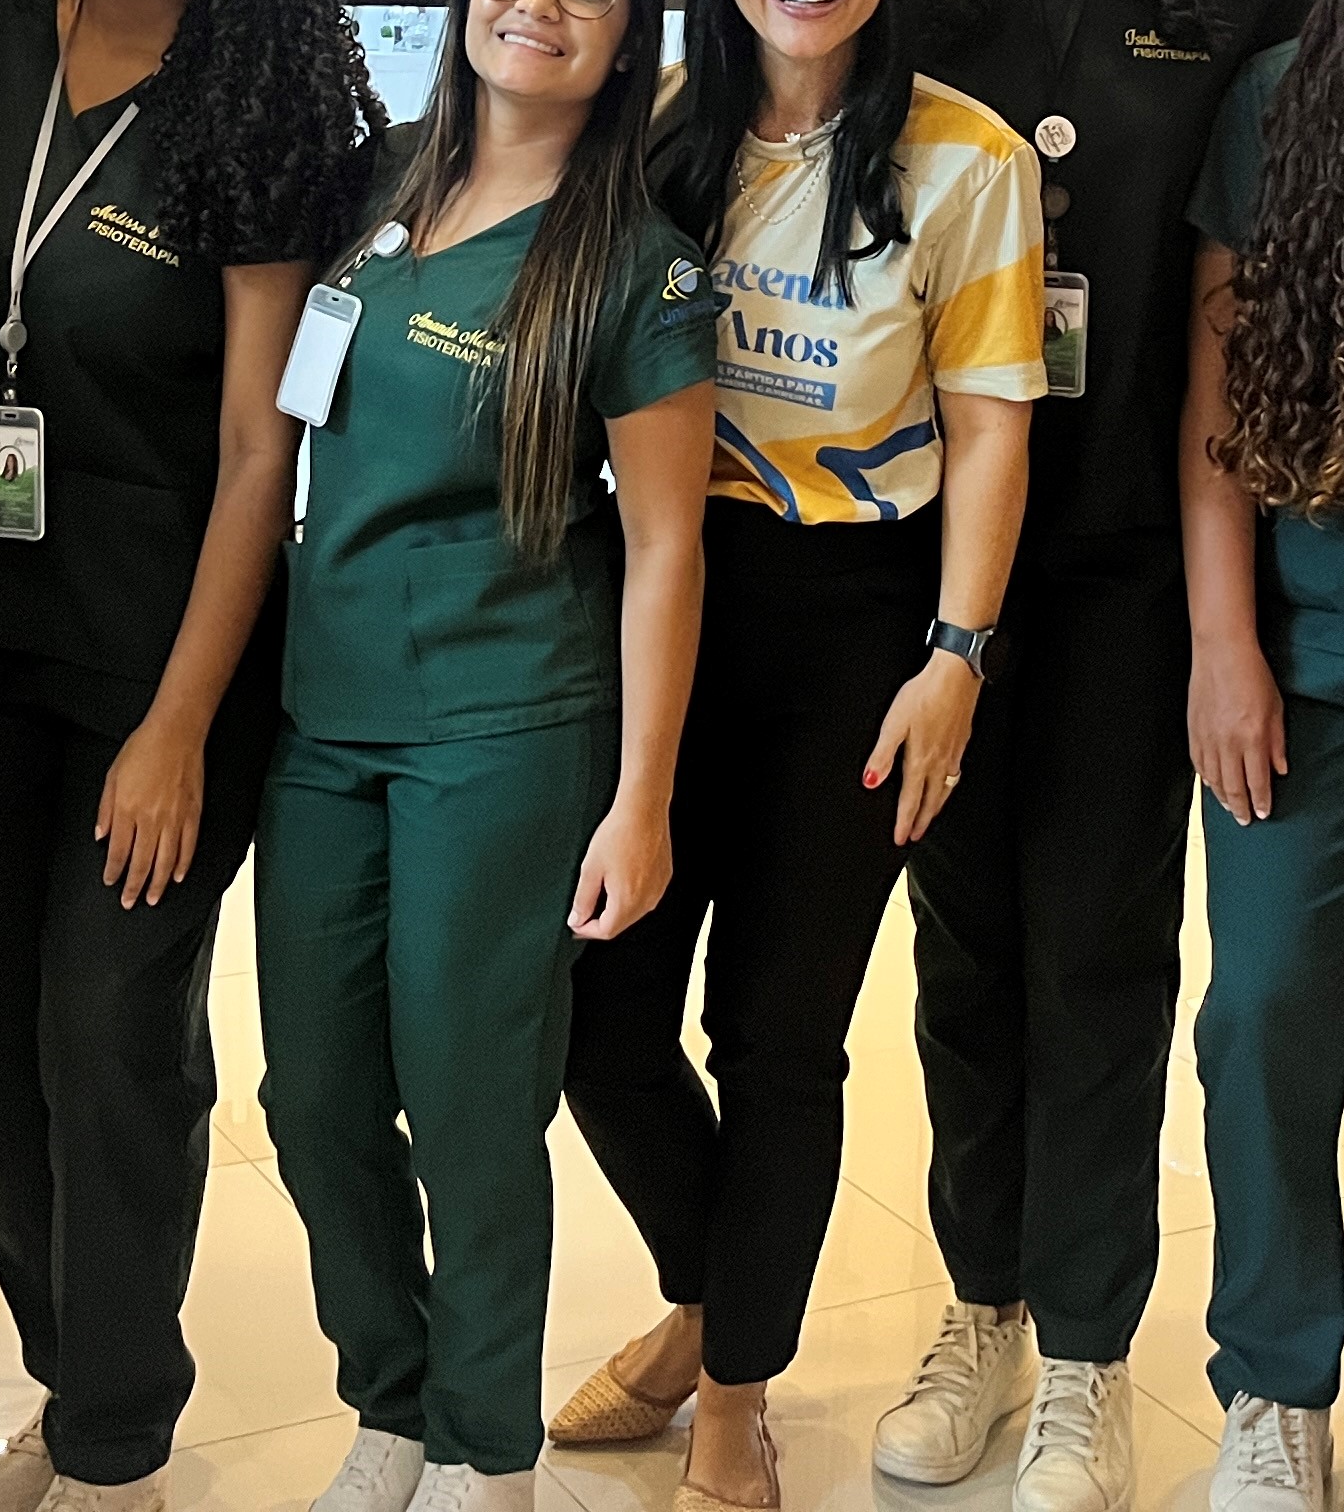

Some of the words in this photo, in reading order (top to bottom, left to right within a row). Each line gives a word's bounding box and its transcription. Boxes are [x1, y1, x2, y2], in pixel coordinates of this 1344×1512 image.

[1133, 47, 1211, 63] FISIOTERAPIA
[87, 220, 180, 268] FISIOTERAPIA
[407, 328, 491, 368] FISIOTERAPA
[726, 366, 785, 389] PARTIDA
[786, 378, 825, 397] PARA
